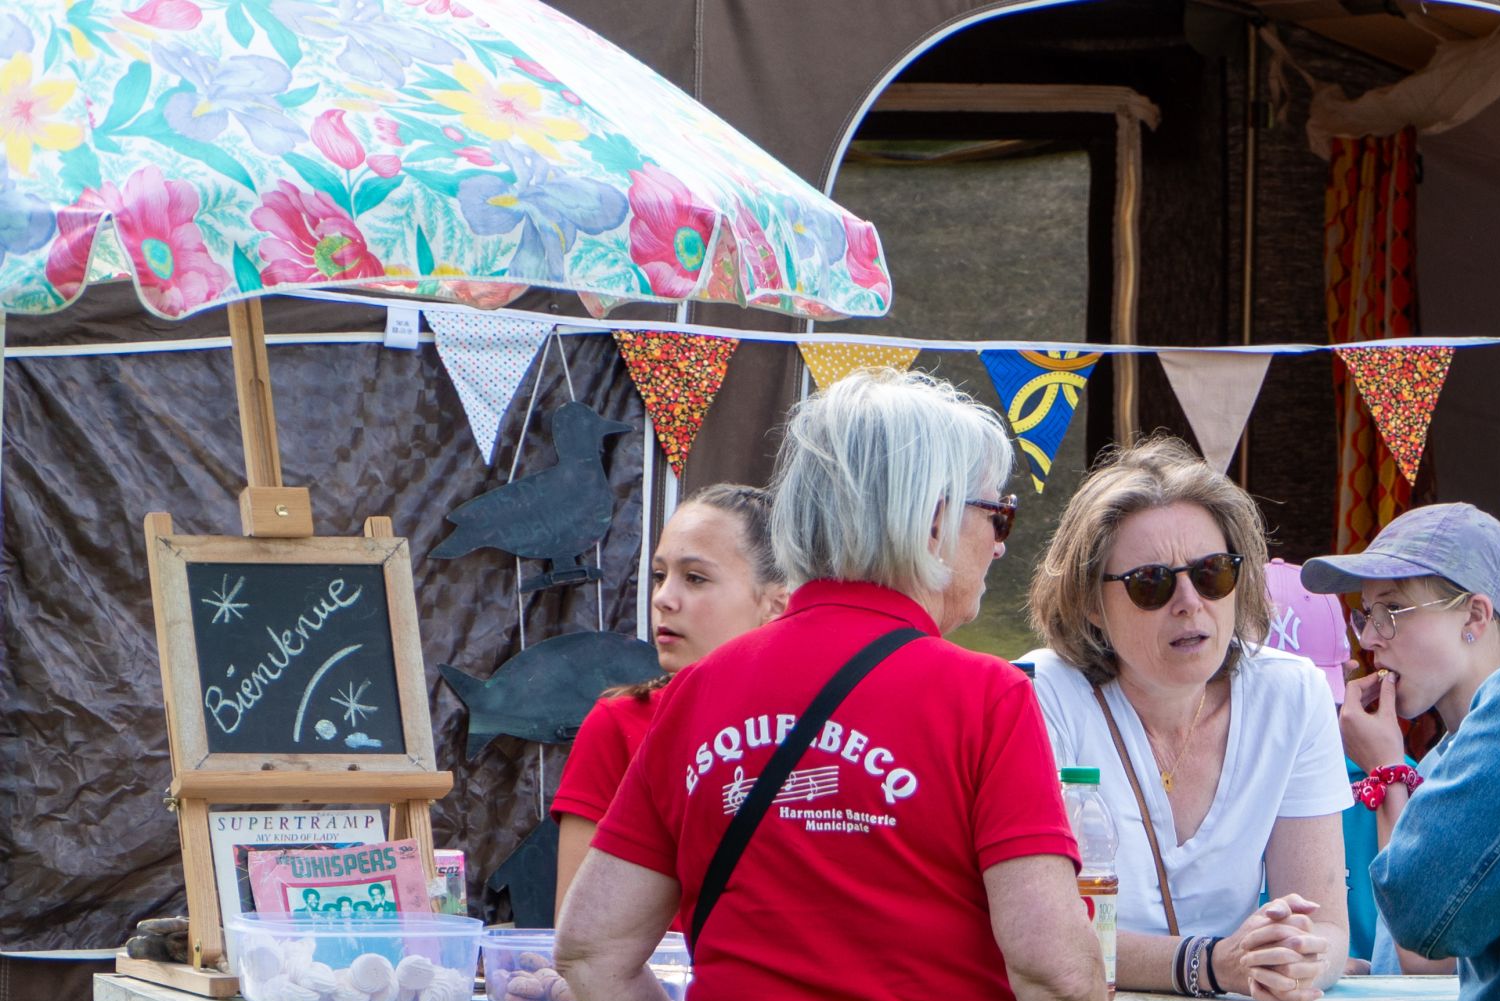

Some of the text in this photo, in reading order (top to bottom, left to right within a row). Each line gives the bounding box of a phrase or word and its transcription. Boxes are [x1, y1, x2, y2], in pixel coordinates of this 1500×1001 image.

[205, 578, 363, 733] Bienvenue
[685, 714, 918, 804] ESQUEBECQ
[217, 815, 375, 831] SUPERTRAMP
[779, 806, 897, 827] Harmonie Batterie
[805, 819, 870, 833] Municipale
[256, 833, 340, 842] MY KIND OF LADY
[290, 847, 397, 879] WHISPERS
